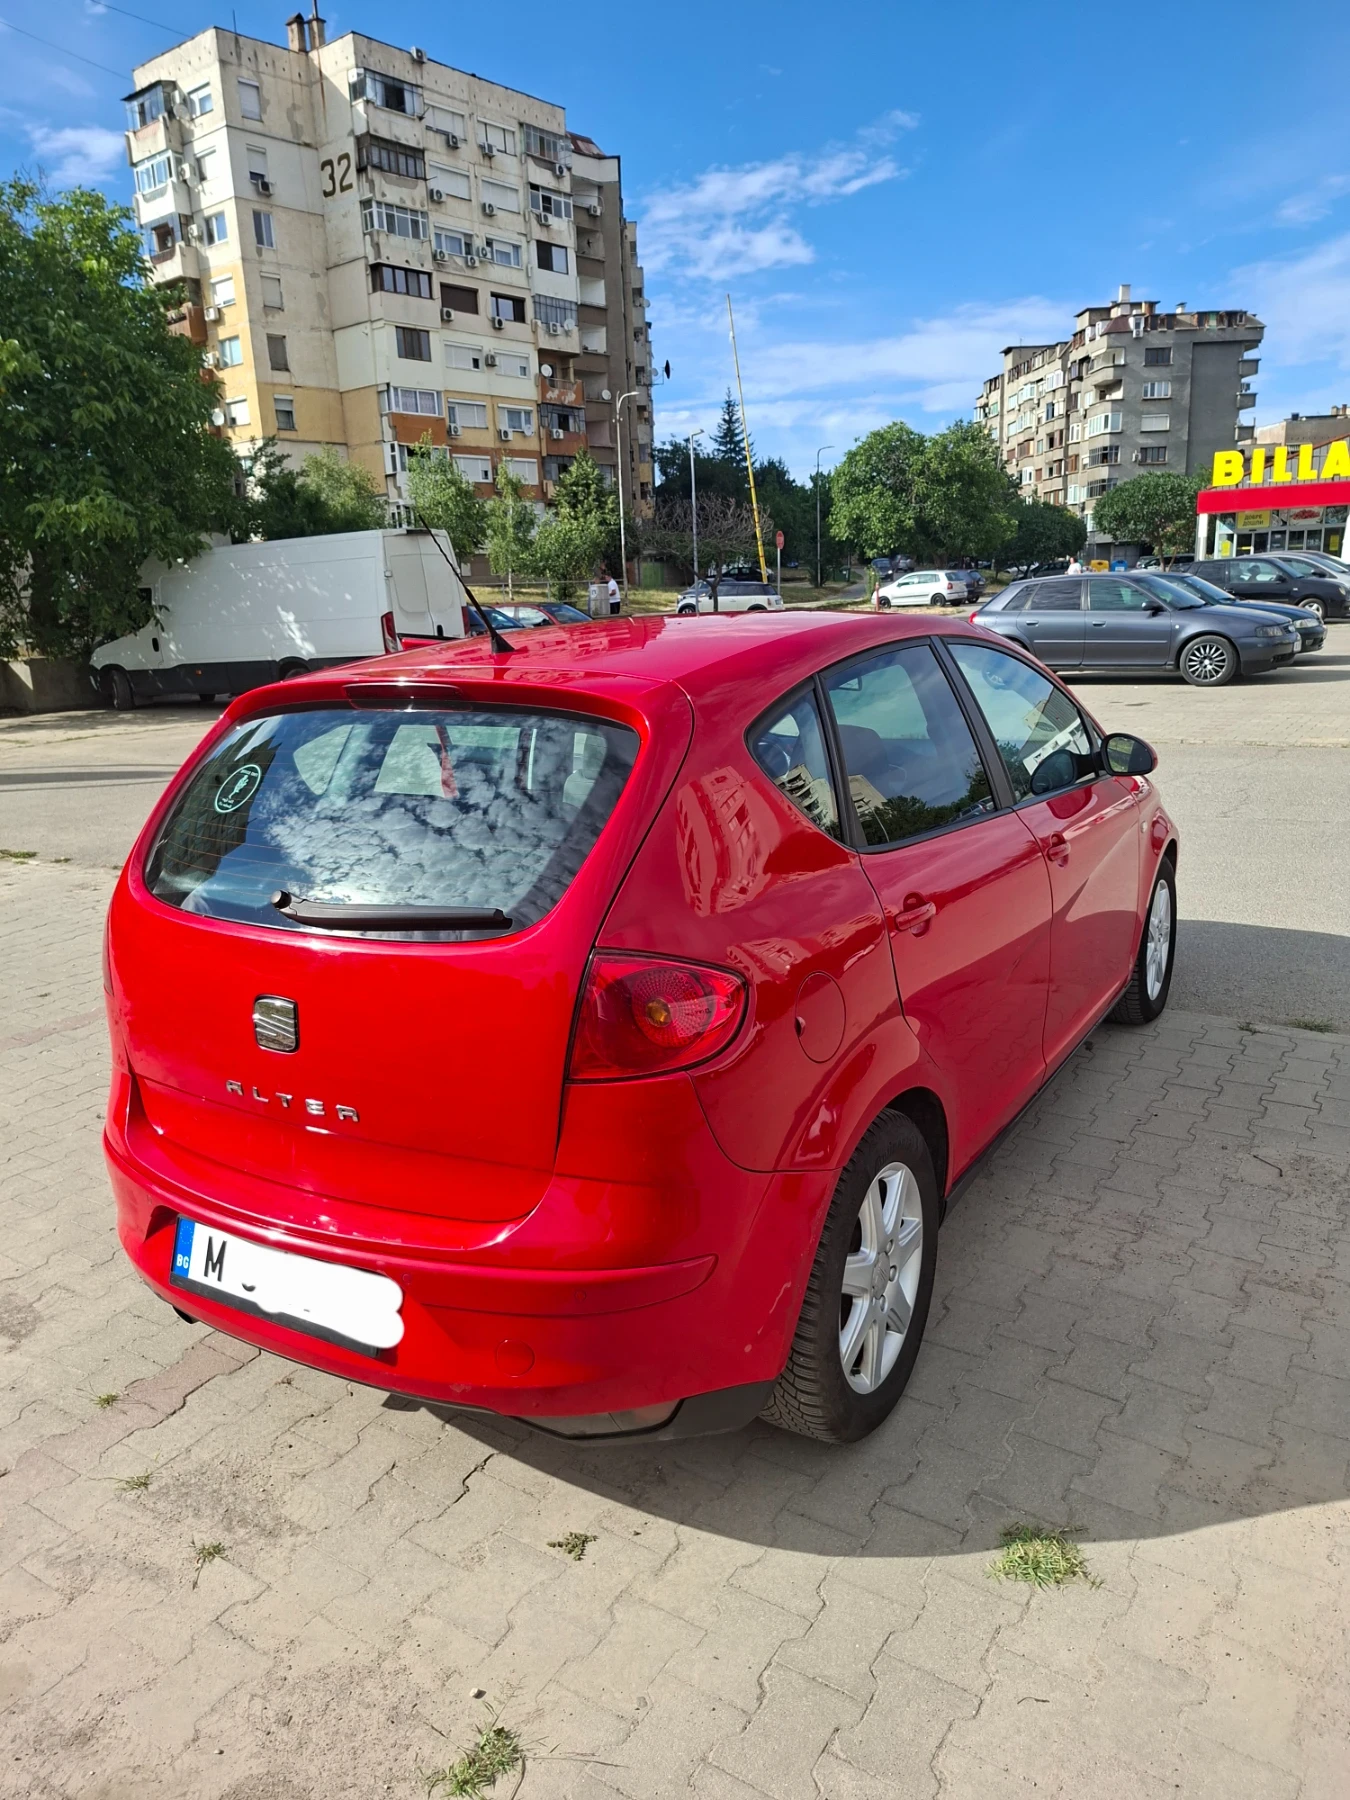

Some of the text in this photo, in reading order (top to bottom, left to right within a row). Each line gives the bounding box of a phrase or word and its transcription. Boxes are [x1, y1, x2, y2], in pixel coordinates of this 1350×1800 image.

[320, 152, 354, 198] 32
[1212, 440, 1350, 487] BILLA
[226, 1079, 359, 1122] ALTEA
[176, 1253, 190, 1269] BG
[203, 1235, 227, 1282] M
